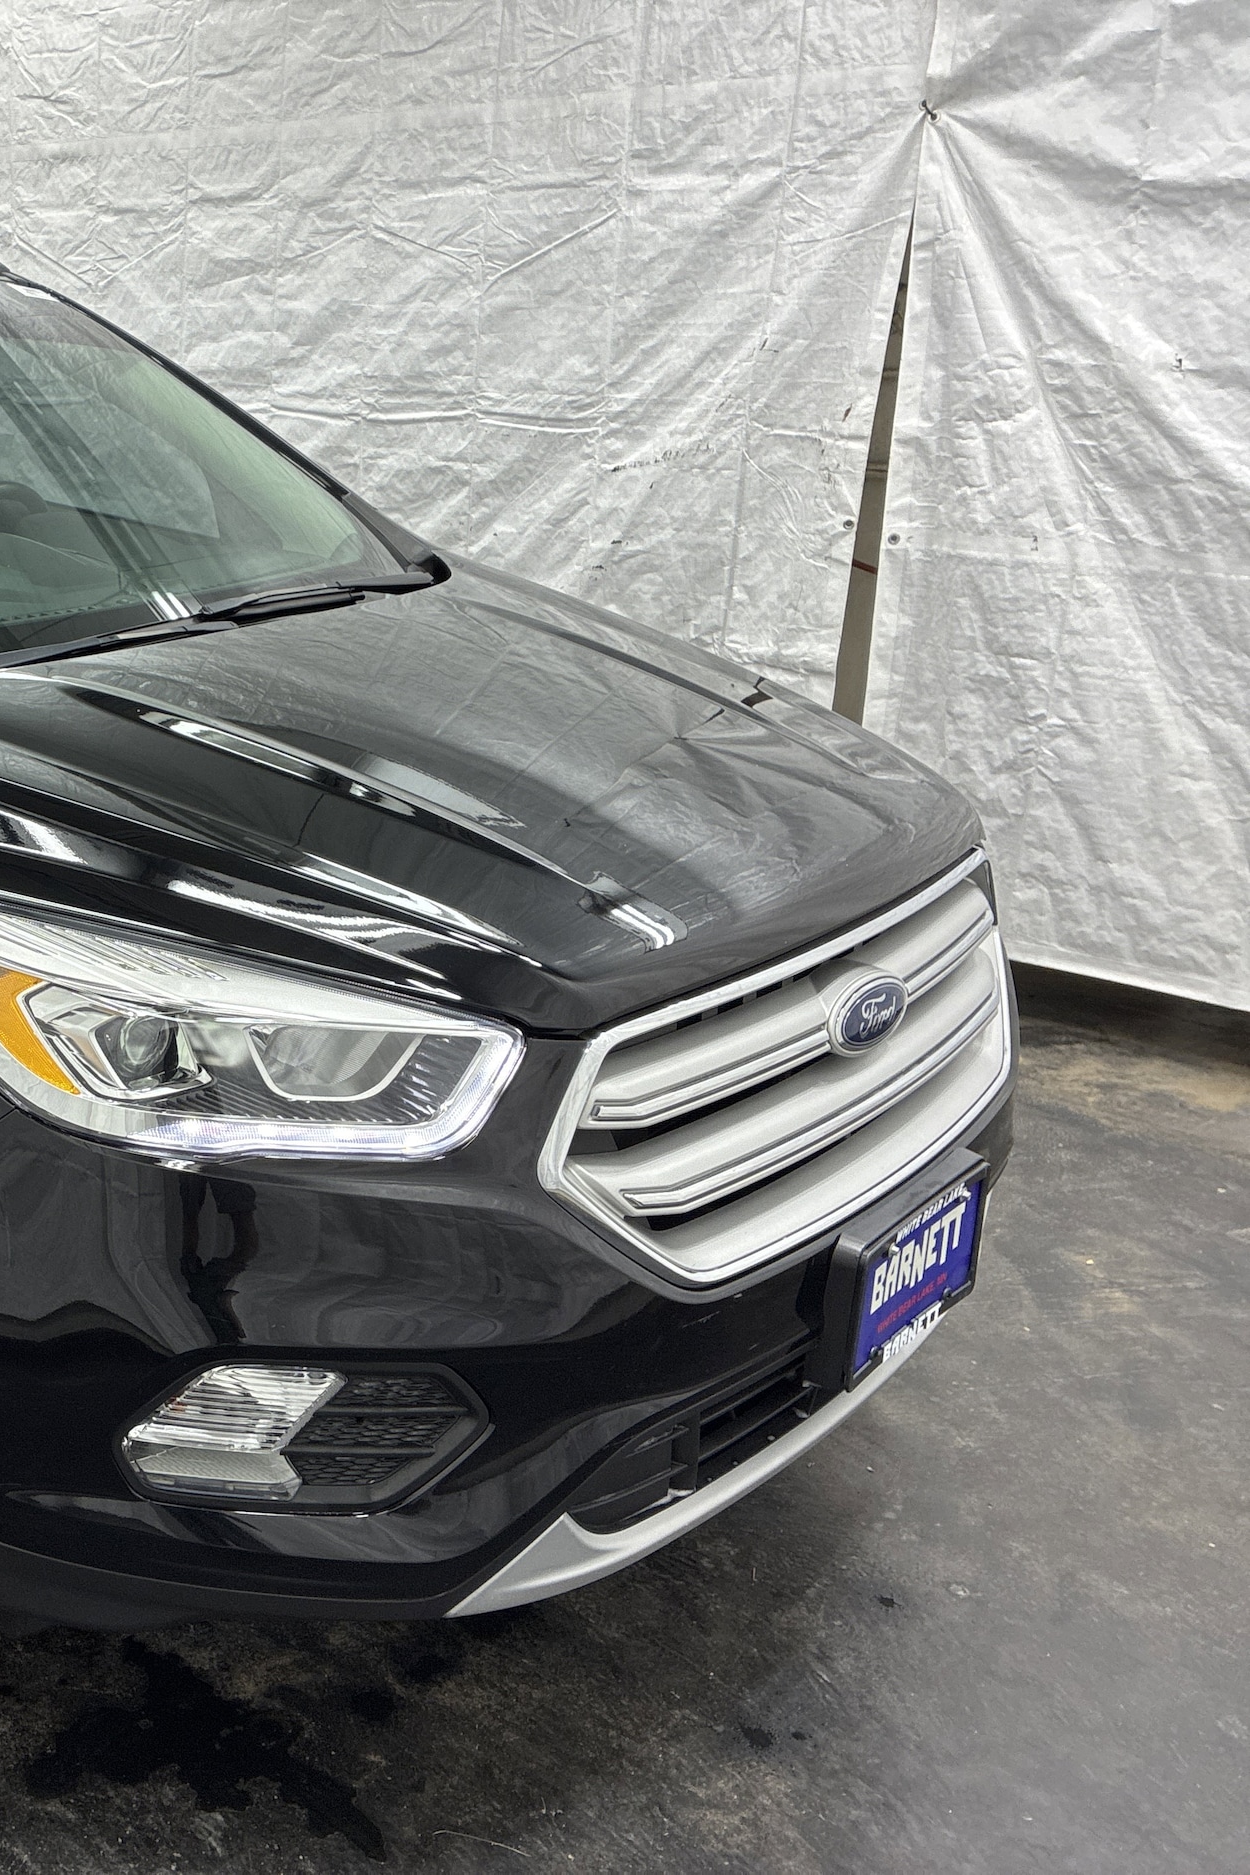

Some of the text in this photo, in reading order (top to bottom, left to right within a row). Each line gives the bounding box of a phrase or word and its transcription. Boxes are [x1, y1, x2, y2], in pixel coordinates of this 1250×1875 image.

[860, 993, 896, 1039] Ford
[895, 1182, 966, 1245] WHITE BEAR LAKE
[870, 1201, 967, 1315] BARNETT
[882, 1301, 943, 1364] BARNETT
